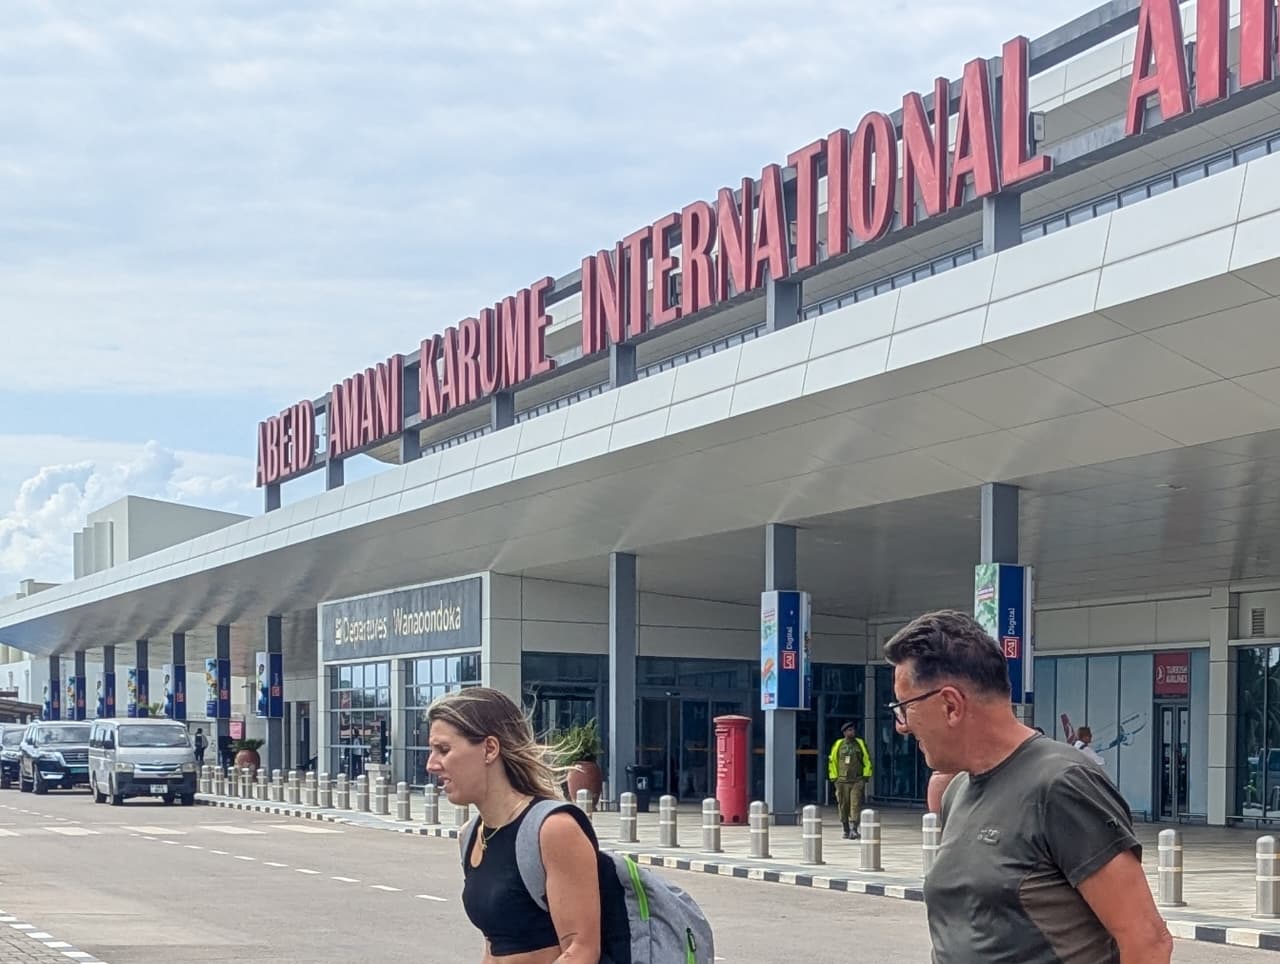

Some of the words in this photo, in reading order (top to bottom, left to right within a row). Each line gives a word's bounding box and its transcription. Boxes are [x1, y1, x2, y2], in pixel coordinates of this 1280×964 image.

[256, 399, 317, 487] ABEID
[327, 353, 402, 459] AMANI
[418, 275, 558, 420] KARUME
[581, 35, 1052, 356] INTERNATIONAL
[342, 616, 388, 649] Departures
[393, 600, 461, 637] Wanaoondoka
[1008, 607, 1017, 635] Digital
